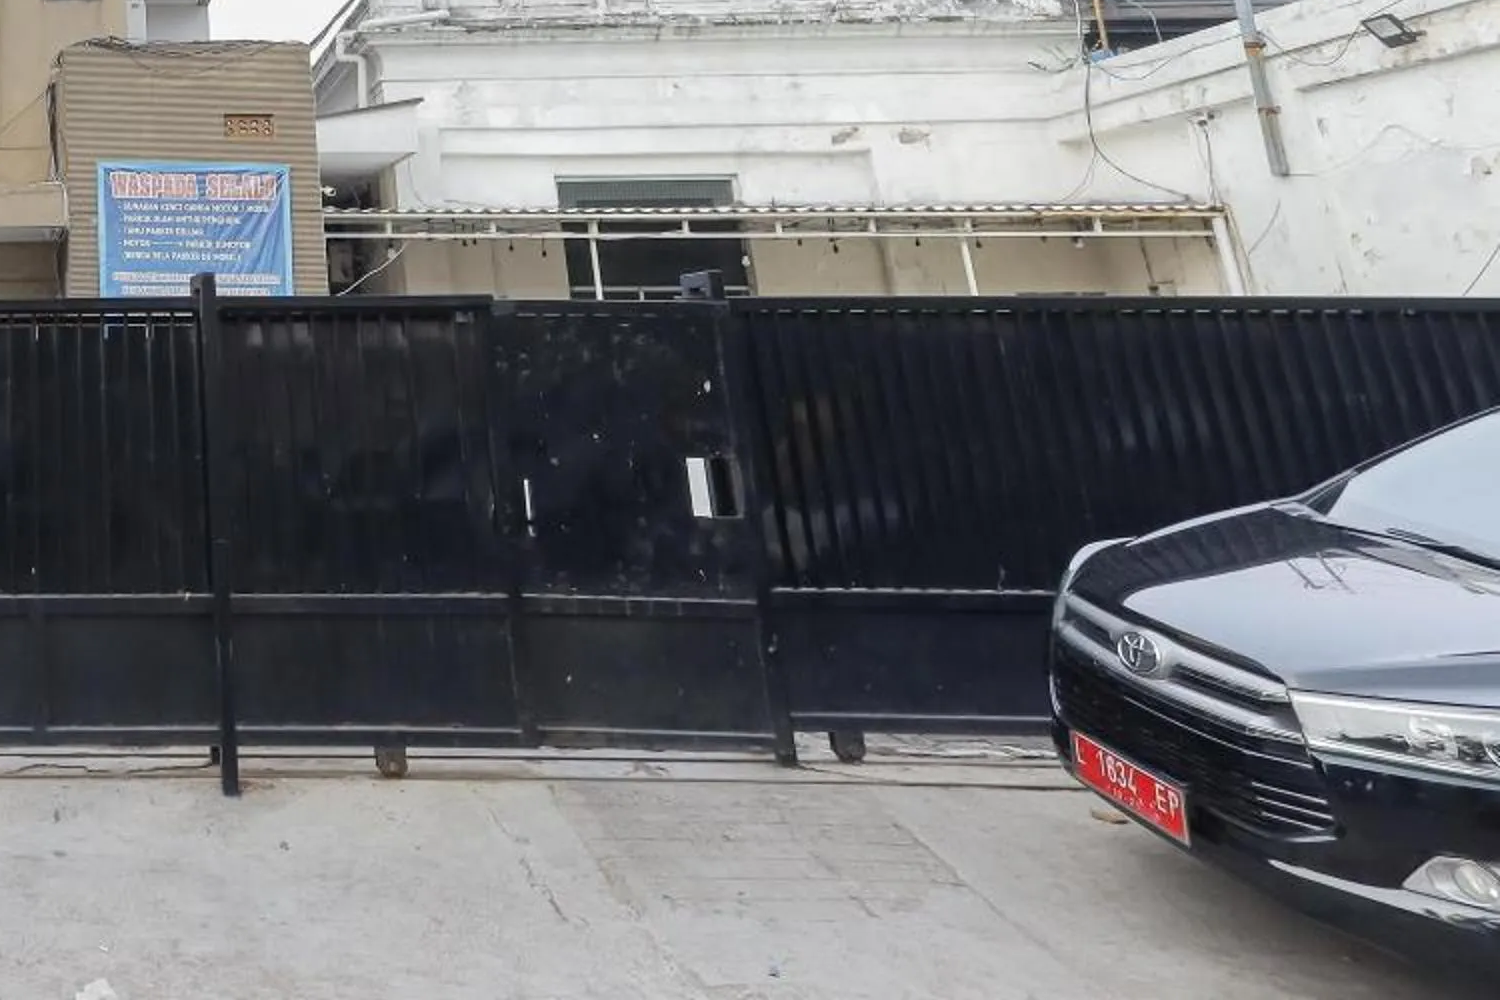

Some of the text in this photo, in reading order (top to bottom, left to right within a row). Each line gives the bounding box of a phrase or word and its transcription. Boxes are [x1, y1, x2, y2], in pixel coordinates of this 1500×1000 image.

[1075, 738, 1087, 765] L
[1096, 750, 1138, 796] 1634
[1154, 783, 1180, 819] EP
